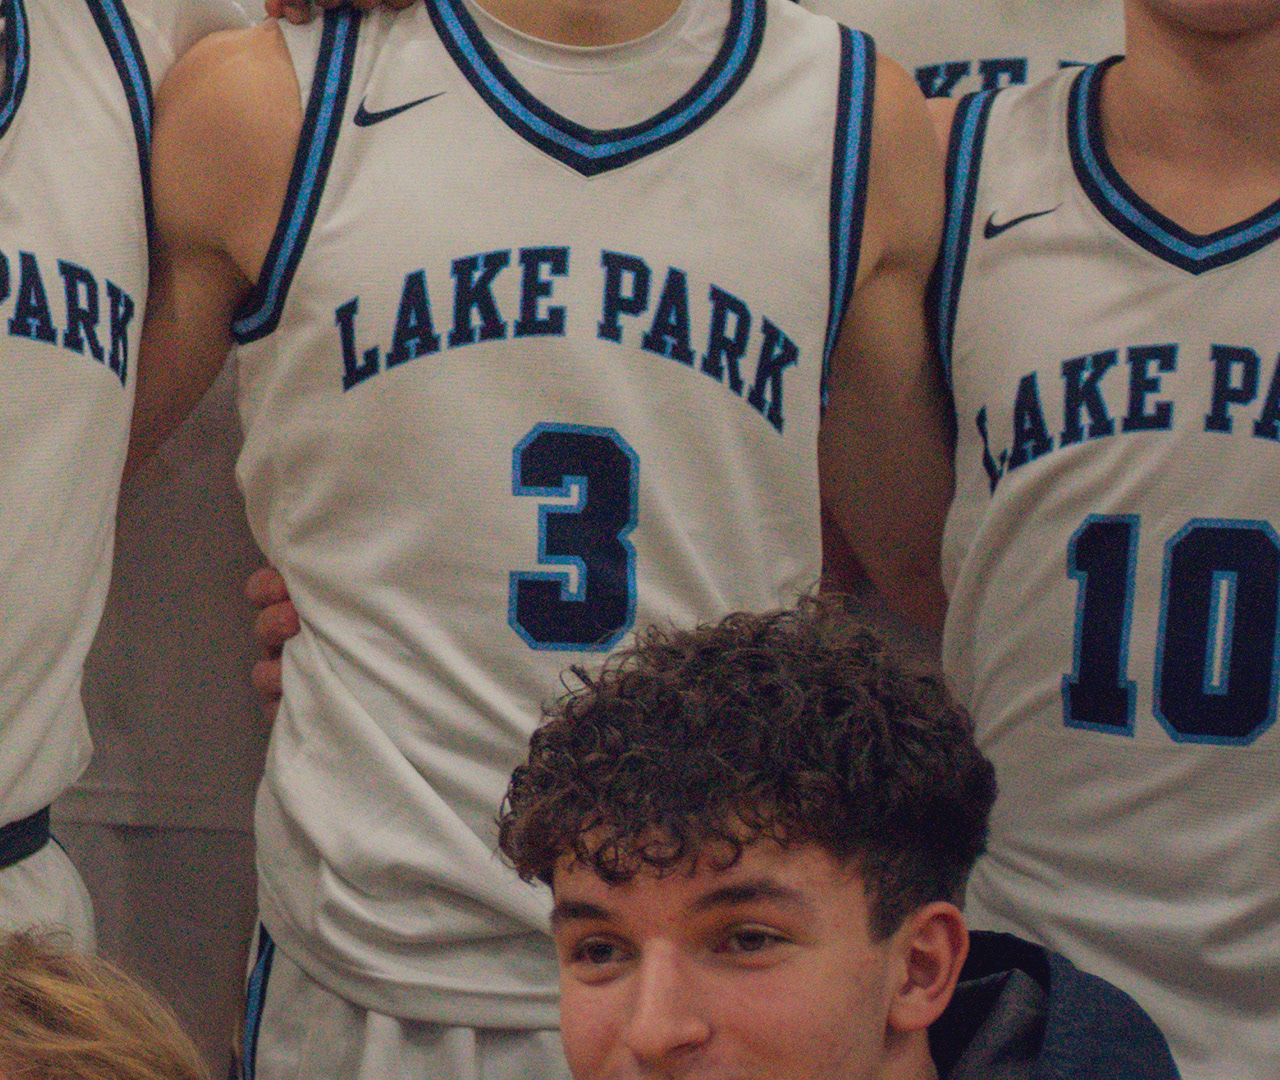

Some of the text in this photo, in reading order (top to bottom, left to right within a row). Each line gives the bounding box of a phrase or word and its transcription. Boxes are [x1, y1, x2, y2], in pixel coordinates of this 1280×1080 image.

[334, 245, 801, 435] LAKE PARK
[976, 343, 1179, 498] LAKE
[508, 421, 640, 651] 3
[1062, 512, 1280, 746] 10
